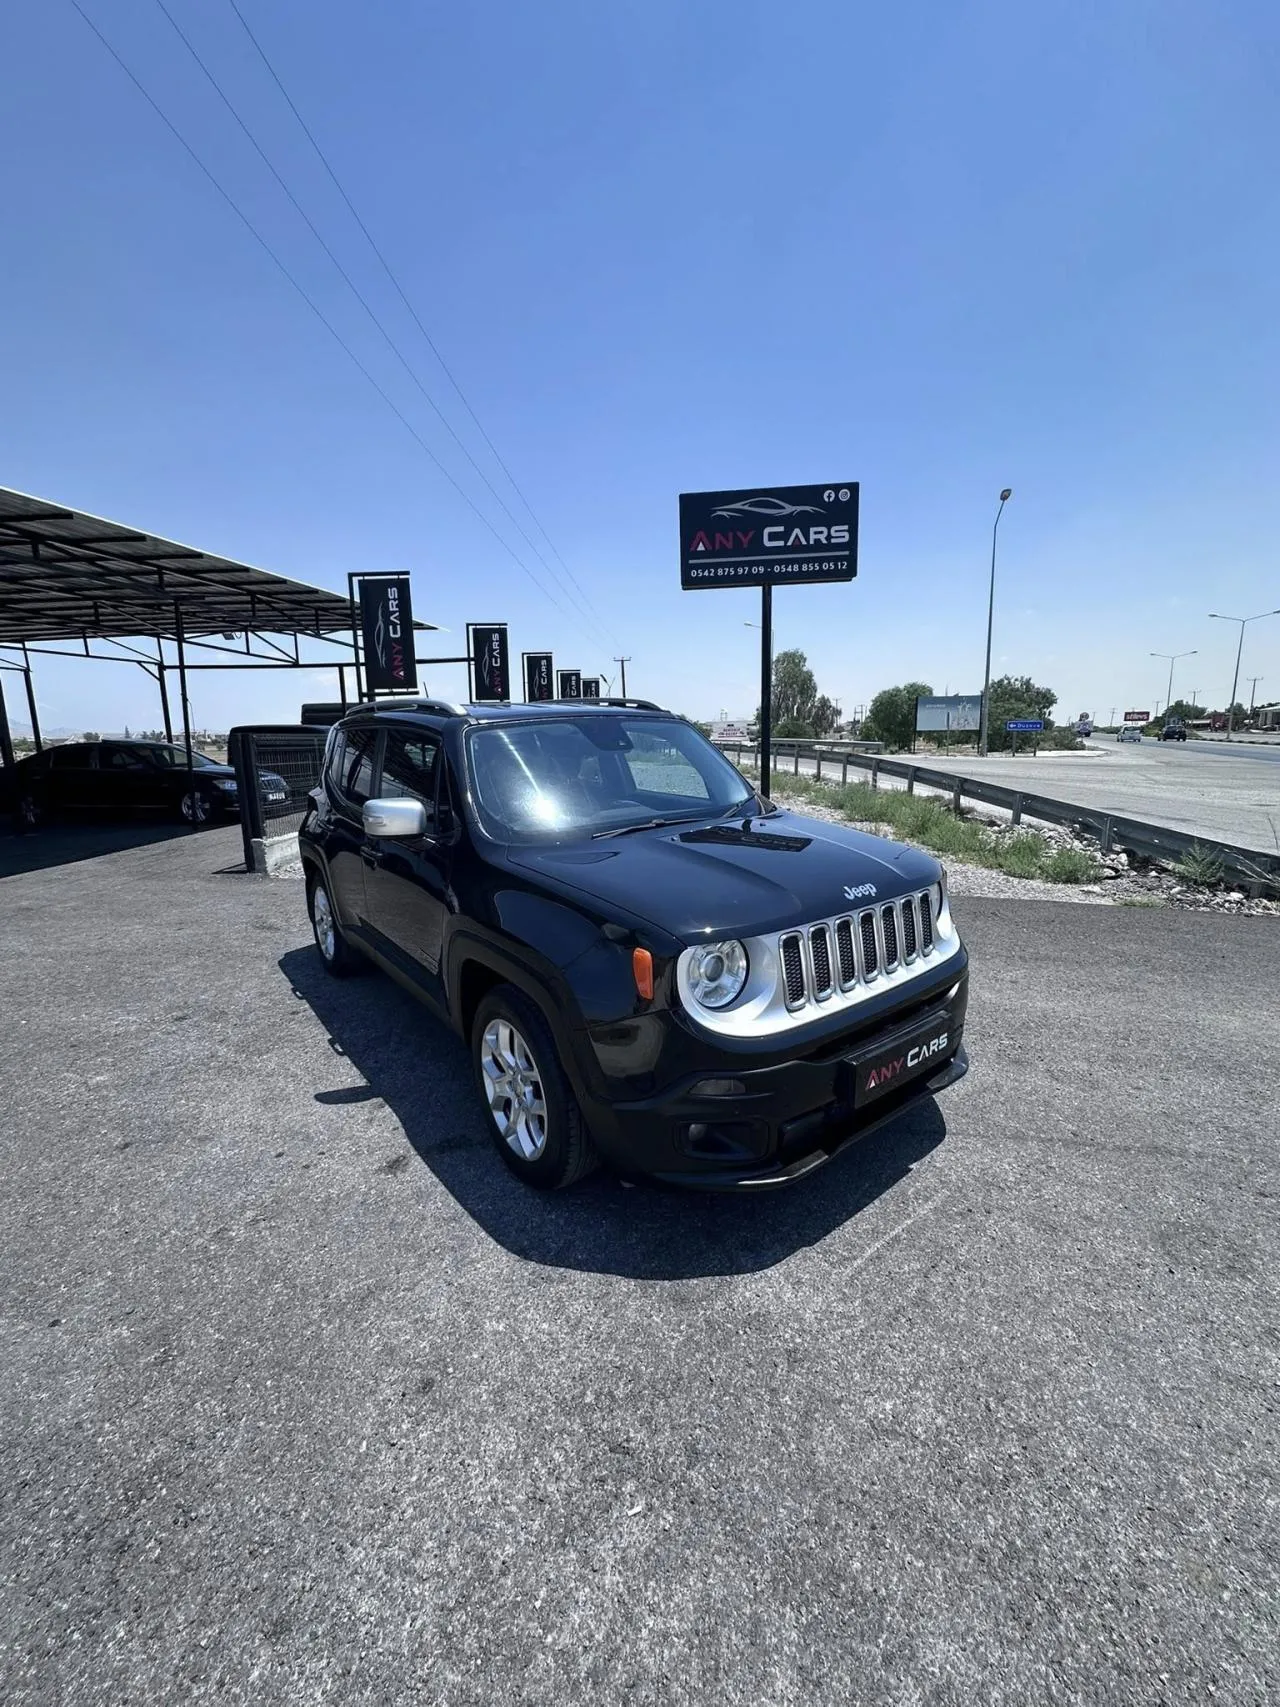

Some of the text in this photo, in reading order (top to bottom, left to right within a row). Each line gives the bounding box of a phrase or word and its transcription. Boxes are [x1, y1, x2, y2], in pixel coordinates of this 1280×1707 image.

[689, 525, 850, 552] ANY CARS
[690, 568, 715, 578] 0542
[717, 567, 735, 576] 875
[737, 566, 749, 575] 97
[751, 565, 765, 574] 09
[773, 563, 799, 573] 0548
[801, 562, 820, 571] 855
[822, 561, 835, 570] 05
[837, 561, 848, 569] 12
[387, 587, 405, 680] ANY CARS
[492, 632, 501, 667] CARS
[540, 659, 548, 685] CARS
[843, 883, 877, 900] Jeep
[865, 1032, 948, 1091] ANY CARS
